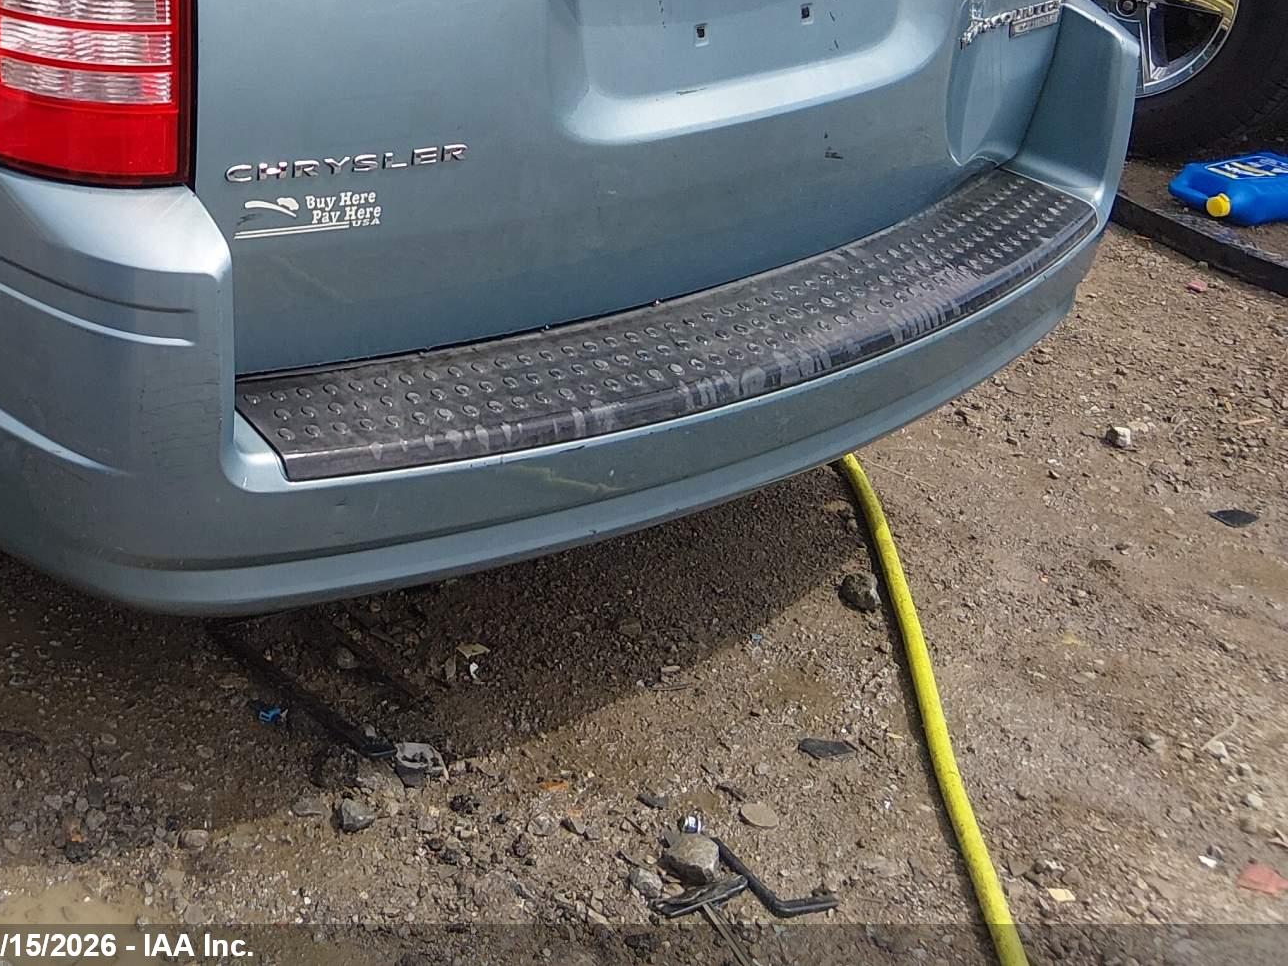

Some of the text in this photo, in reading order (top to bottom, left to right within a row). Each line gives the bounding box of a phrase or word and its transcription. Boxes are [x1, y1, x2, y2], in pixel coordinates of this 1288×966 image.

[225, 143, 468, 182] CHRYSLER
[305, 191, 377, 211] Buy Here
[311, 206, 382, 225] Pay Here
[352, 218, 380, 227] USA
